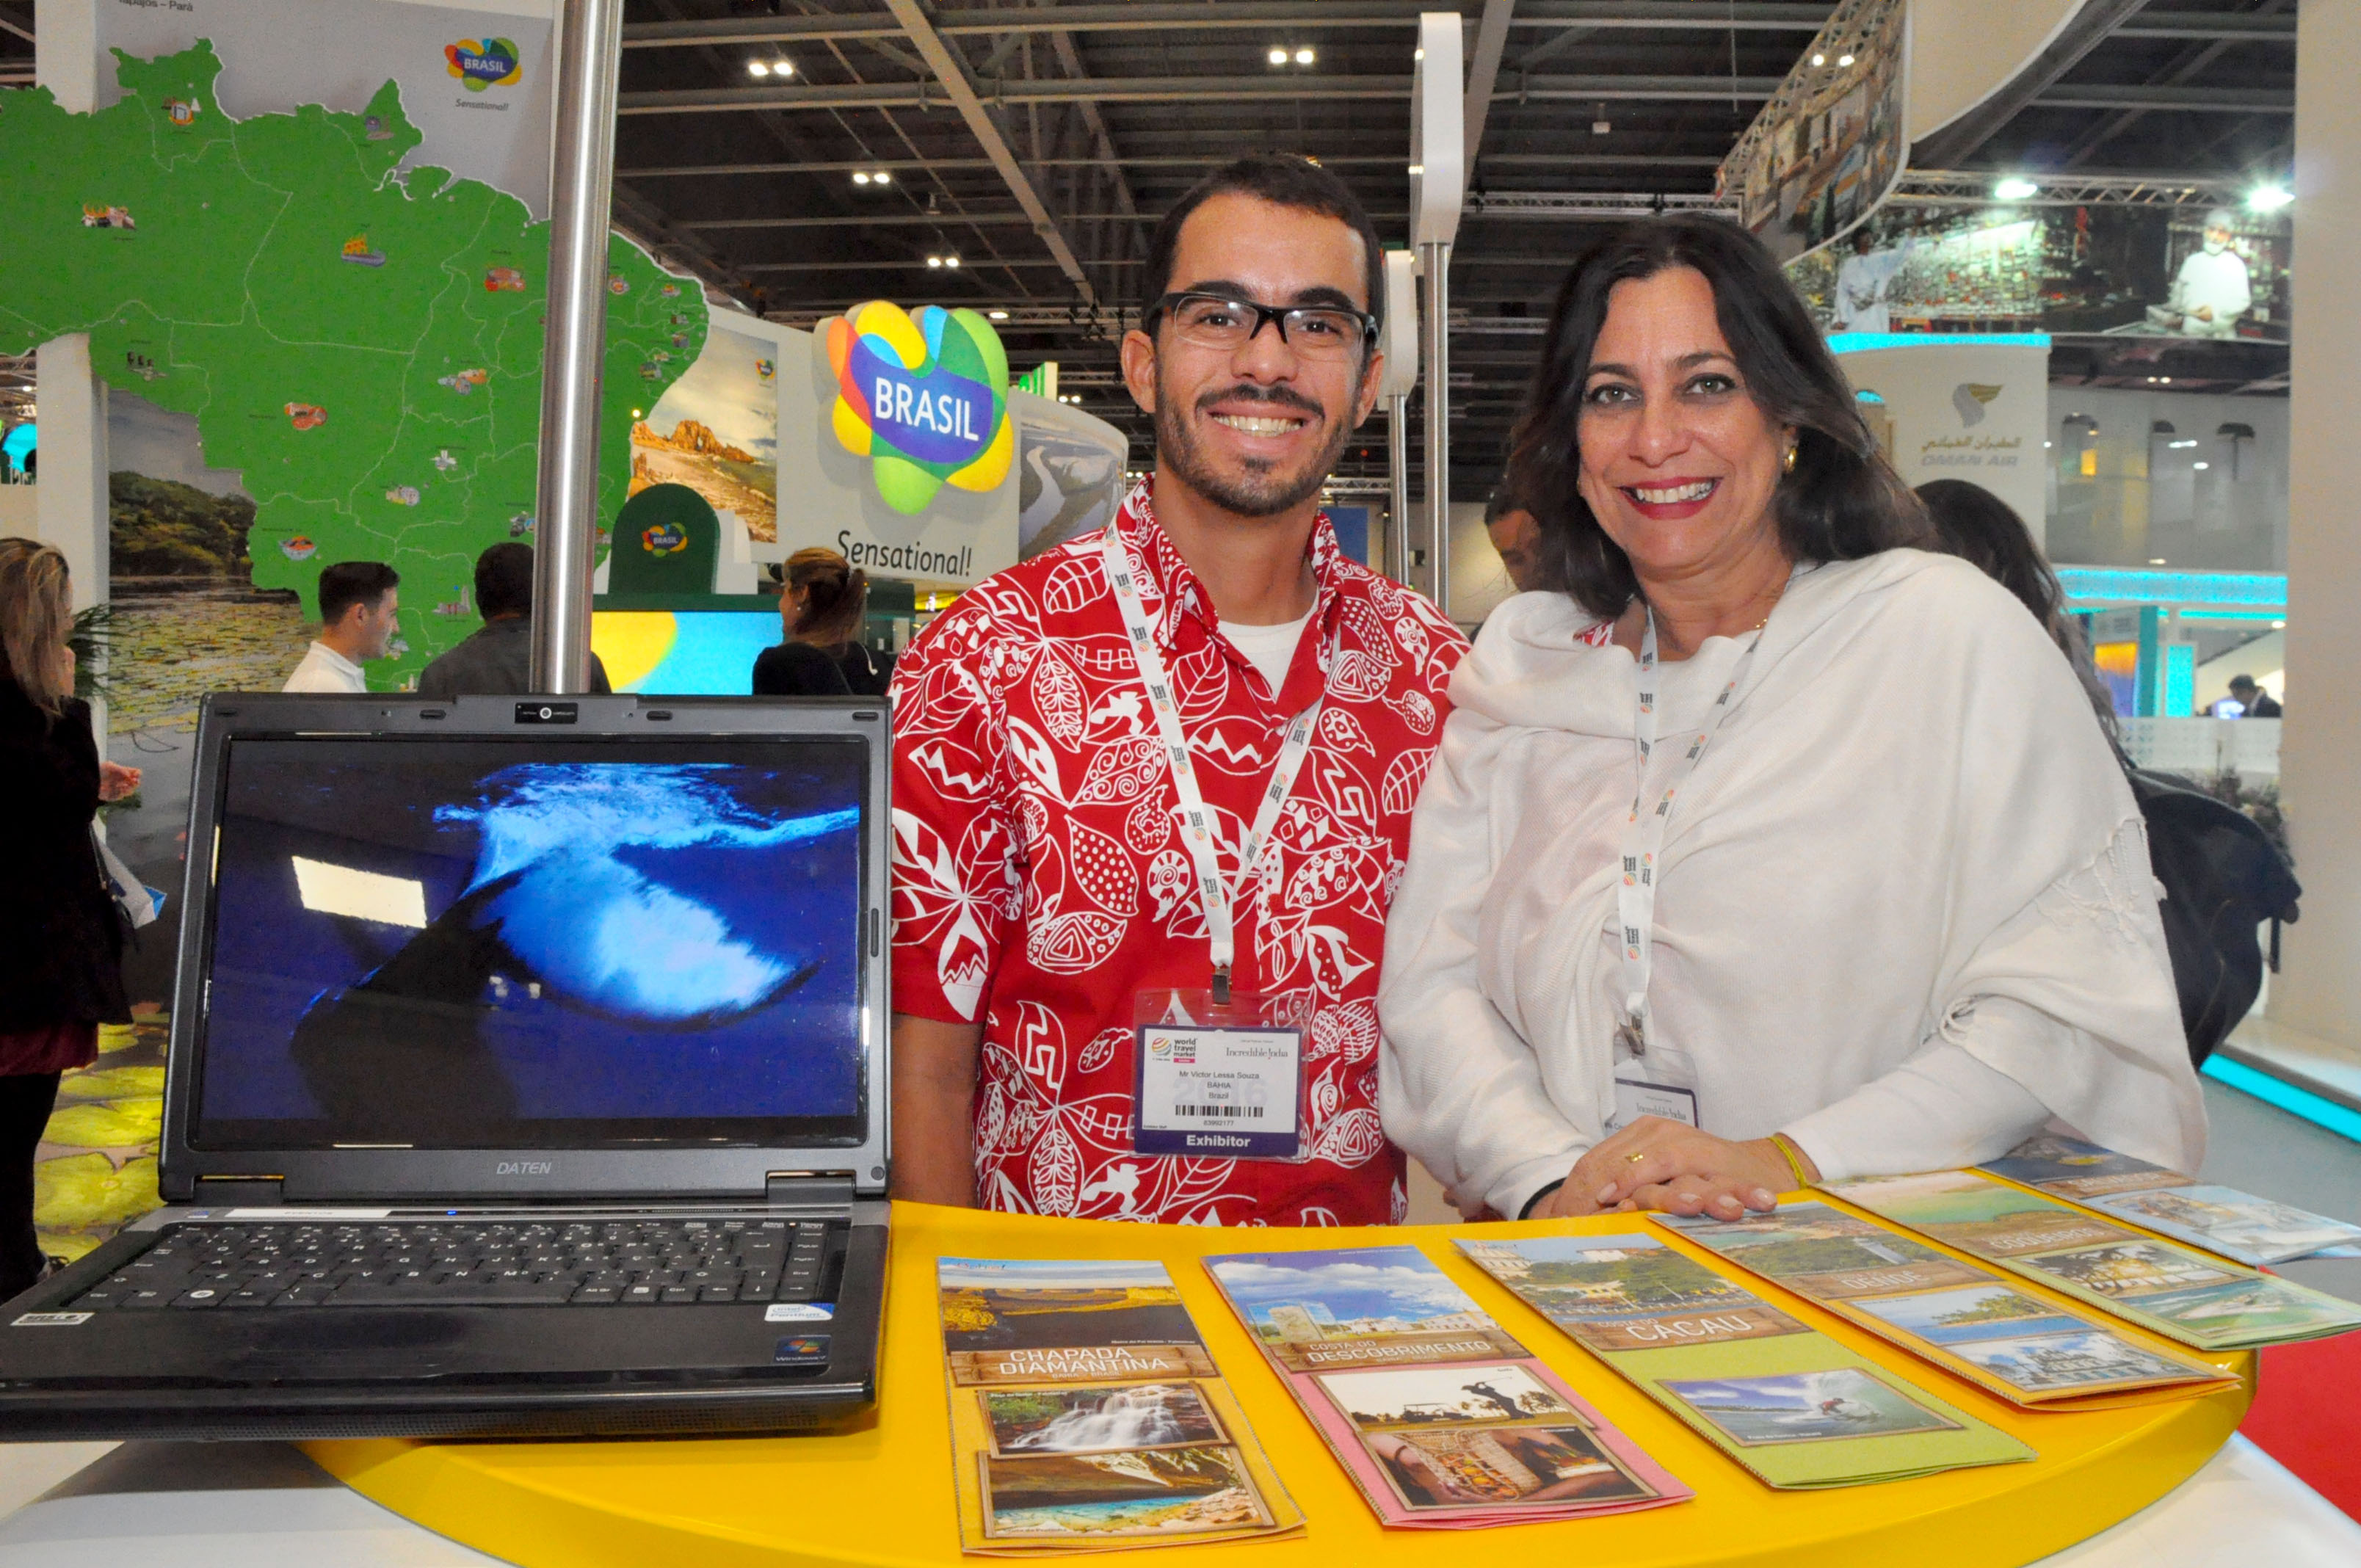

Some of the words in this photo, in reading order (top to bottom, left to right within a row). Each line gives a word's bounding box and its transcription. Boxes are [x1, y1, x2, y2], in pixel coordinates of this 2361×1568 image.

[463, 57, 507, 73] BRASIL
[455, 98, 509, 112] Sensational!
[874, 376, 979, 442] BRASIL
[1987, 455, 2018, 466] AIR
[653, 536, 679, 545] BRASIL
[838, 529, 973, 577] Sensational!
[1226, 1047, 1267, 1057] Incredible
[1191, 1070, 1211, 1078] Victor
[1186, 1134, 1251, 1147] Exhibitor
[496, 1161, 552, 1175] DATEN
[1625, 1315, 1755, 1341] CACAU
[1307, 1340, 1492, 1363] DESCOBRIMENTO
[1310, 1341, 1354, 1351] COSTA
[1009, 1346, 1133, 1362] CHAPADA
[998, 1357, 1169, 1375] DIAMANTINA
